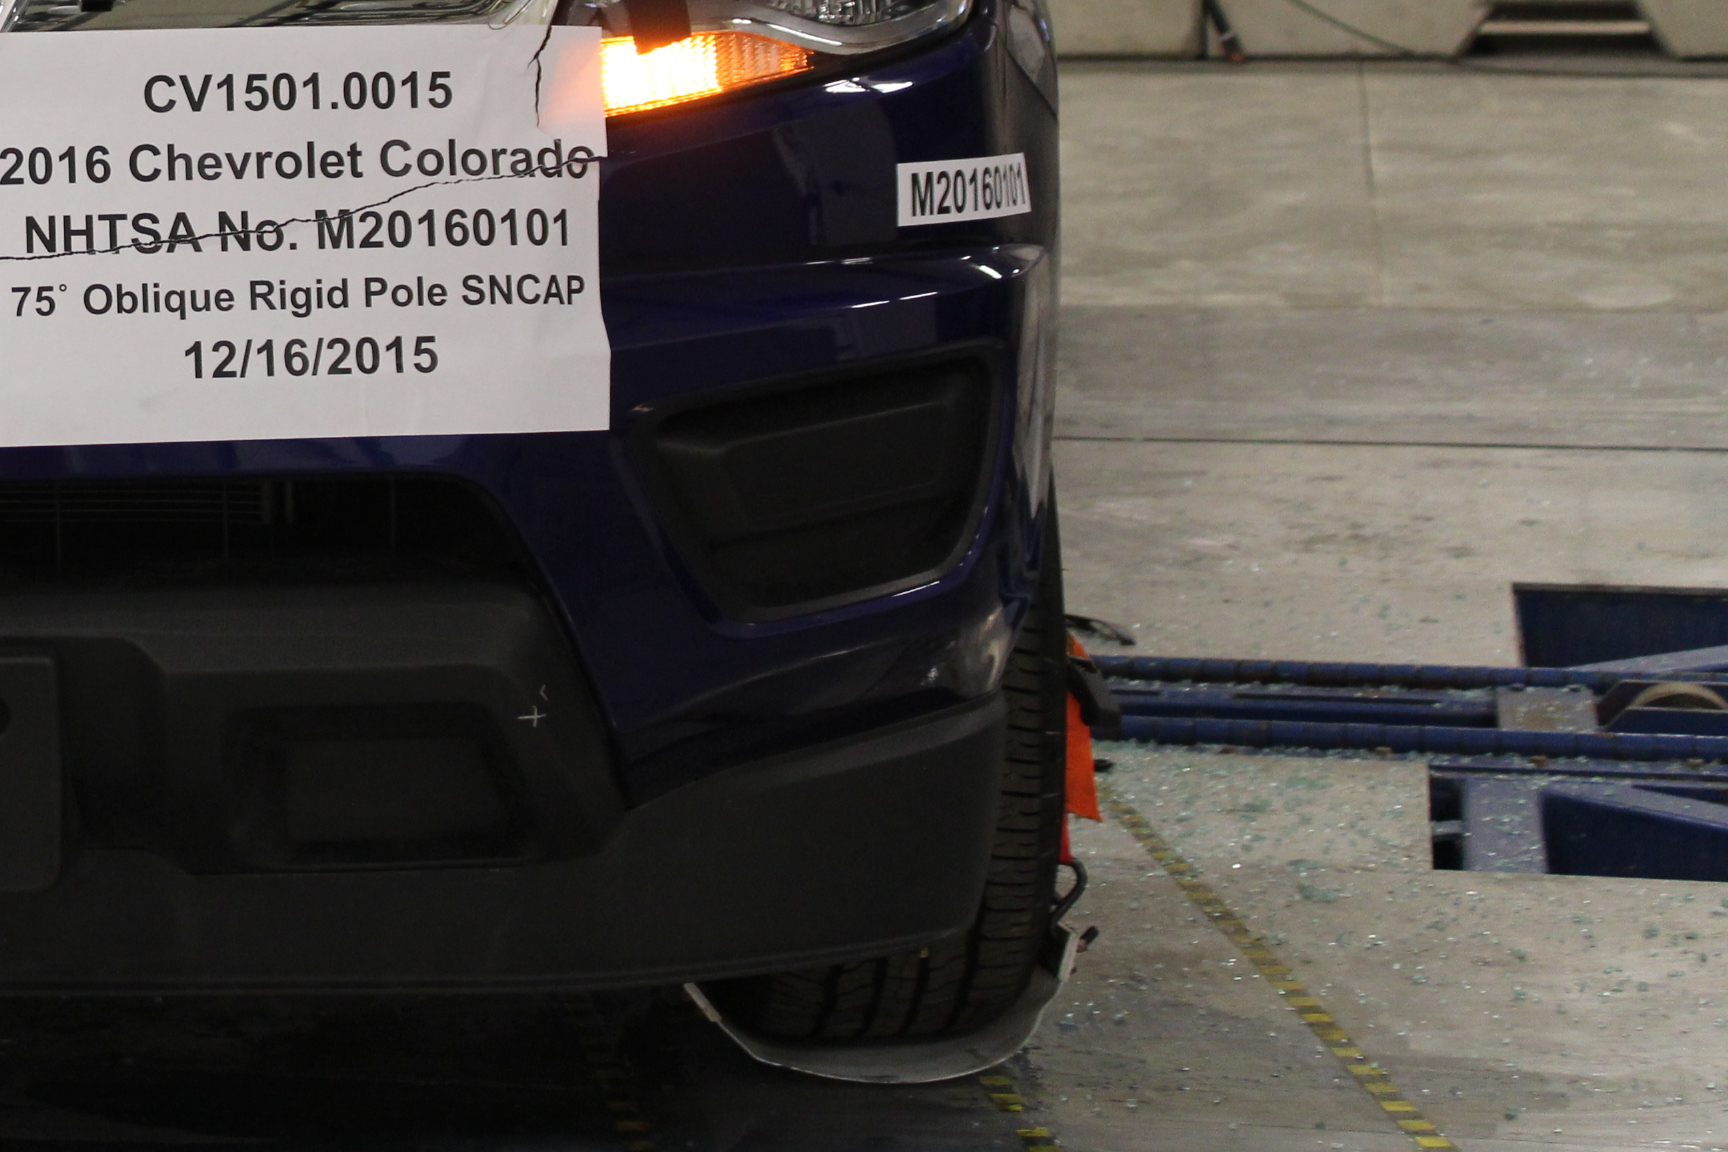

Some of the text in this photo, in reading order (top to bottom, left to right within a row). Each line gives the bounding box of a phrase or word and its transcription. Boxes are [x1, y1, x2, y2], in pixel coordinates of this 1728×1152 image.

[144, 71, 452, 113] CV1501.0015
[0, 138, 591, 185] 2016 Chevrolet Colorado
[912, 163, 1026, 216] M20160101
[25, 208, 569, 254] NHTSA No. M20160101
[84, 283, 234, 320] Oblique
[250, 278, 348, 317] Rigid
[365, 276, 447, 307] Pole
[462, 274, 584, 305] SNCAP
[185, 336, 437, 378] 12/16/2015
